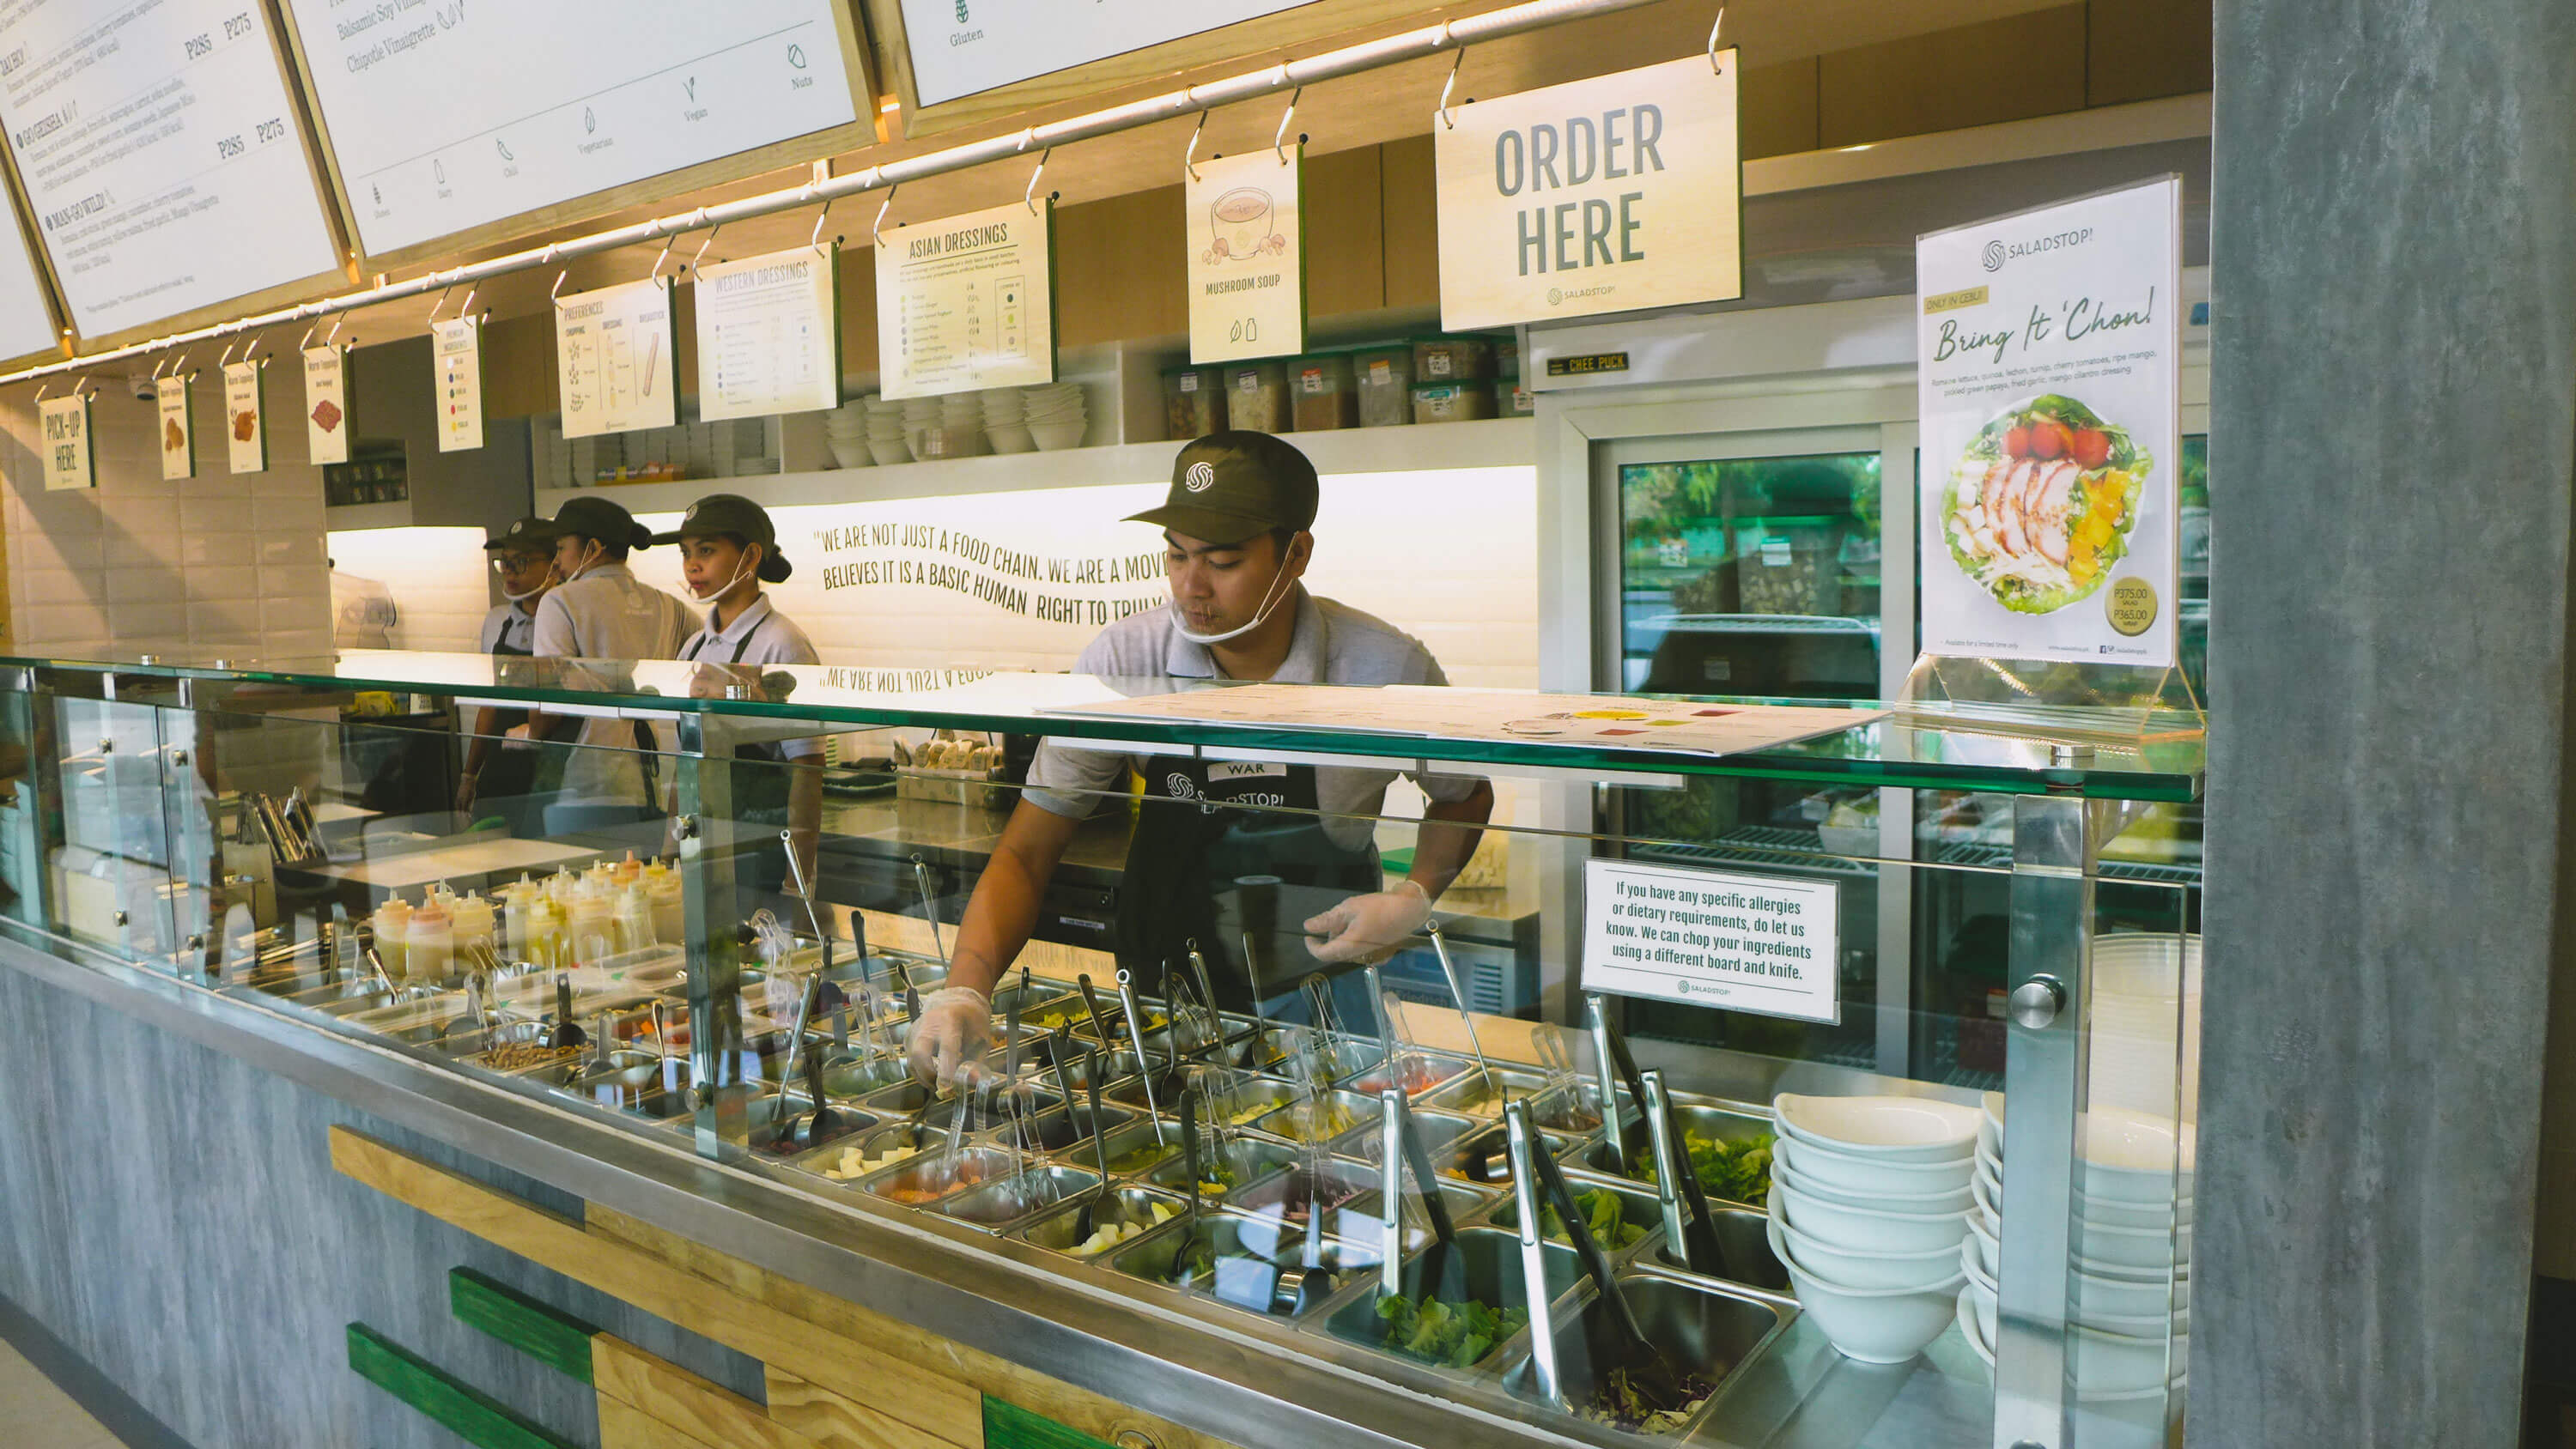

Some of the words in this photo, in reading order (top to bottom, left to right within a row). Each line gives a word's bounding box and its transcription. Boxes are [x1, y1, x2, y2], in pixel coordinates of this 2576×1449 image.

[185, 33, 213, 60] P285
[223, 12, 252, 40] P275
[337, 9, 378, 40] Balsamic
[376, 3, 395, 21] Soy
[950, 27, 984, 48] Gluten
[346, 43, 386, 73] Chipotle
[383, 22, 436, 55] Vinaigrette
[791, 75, 814, 91] Nuts
[683, 107, 708, 123] Vegan
[217, 135, 245, 160] P285
[256, 118, 284, 143] P275
[1495, 104, 1665, 197] ORDER
[909, 235, 941, 259] ASIAN
[945, 222, 1007, 252] DRESSINGS
[1516, 191, 1645, 276] HERE
[2009, 227, 2093, 259] SALADSTOP!
[715, 272, 755, 294] WESTERN
[757, 261, 809, 283] DRESSINGS
[1206, 276, 1255, 295] MUSHROOM
[1257, 274, 1281, 288] SOUP
[1564, 286, 1616, 300] SALADSTOP!
[1934, 319, 2014, 364] Bring
[2024, 304, 2051, 351] It
[1570, 357, 1594, 372] CHEE
[2054, 361, 2074, 370] cherry
[2112, 353, 2126, 363] ripe
[2129, 350, 2157, 360] mango,
[46, 409, 81, 440] PICK-UP
[56, 444, 76, 473] HERE
[845, 524, 868, 549] ARE
[872, 523, 897, 547] NOT
[902, 523, 935, 549] JUST
[939, 529, 948, 552] A
[952, 531, 990, 565] FOOD
[993, 546, 1042, 580] CHAIN.
[1048, 557, 1071, 583] WE
[1076, 558, 1105, 584] ARE
[1110, 557, 1121, 583] A
[823, 561, 878, 591] BELIEVES
[883, 561, 894, 584] IT
[900, 561, 912, 584] IS
[916, 561, 925, 585] A
[929, 563, 969, 593] BASIC
[973, 573, 1027, 615] HUMAN
[1036, 595, 1082, 624] RIGHT
[1087, 599, 1107, 626] TO
[2114, 589, 2148, 598] P375.00
[2114, 609, 2148, 620] P365.00
[1227, 763, 1265, 775] WAR
[1617, 881, 1625, 894] If
[1627, 885, 1646, 899] you
[1649, 884, 1675, 900] have
[1679, 890, 1698, 906] any
[1702, 893, 1746, 908] specific
[1749, 896, 1801, 916] allergies
[1613, 904, 1625, 915] or
[1627, 903, 1666, 923] dietary
[1669, 910, 1750, 932] requirements,
[1754, 918, 1768, 932] do
[1771, 919, 1787, 934] let
[1791, 925, 1804, 937] us
[1606, 920, 1637, 937] know.
[1641, 925, 1657, 940] We
[1661, 930, 1680, 943] can
[1683, 931, 1710, 949] chop
[1714, 937, 1740, 950] your
[1743, 937, 1812, 960] ingredients
[1613, 943, 1642, 961] using
[1645, 949, 1651, 960] a
[1655, 948, 1704, 967] different
[1708, 955, 1741, 972] board
[1744, 961, 1765, 975] and
[1770, 961, 1803, 979] knife.
[1691, 985, 1731, 996] SALADSTOP!
